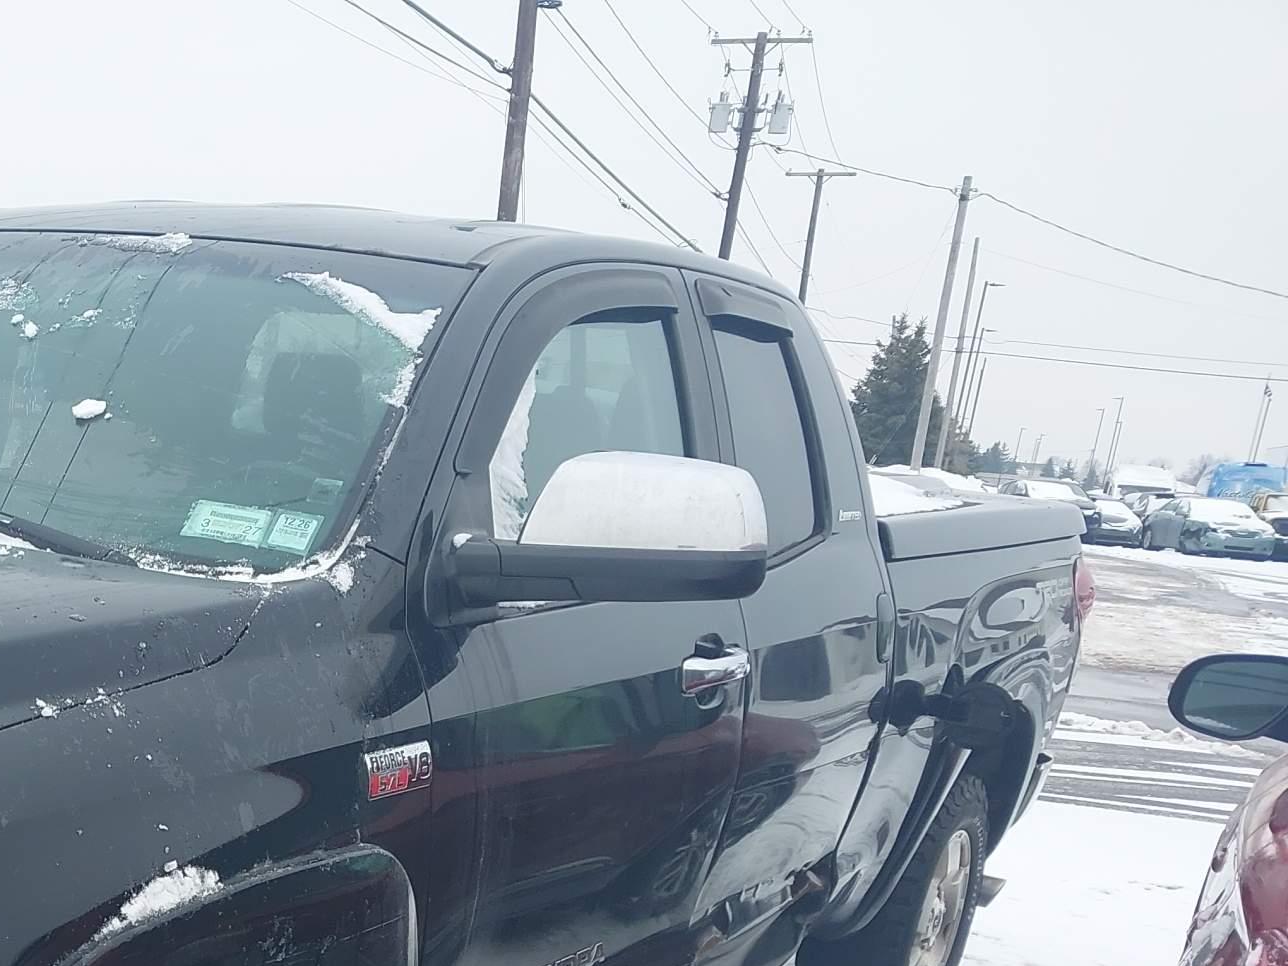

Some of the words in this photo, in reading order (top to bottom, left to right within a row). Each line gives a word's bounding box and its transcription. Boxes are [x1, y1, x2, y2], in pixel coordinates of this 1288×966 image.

[200, 518, 211, 528] 3
[241, 525, 262, 536] 27
[406, 751, 431, 782] V8
